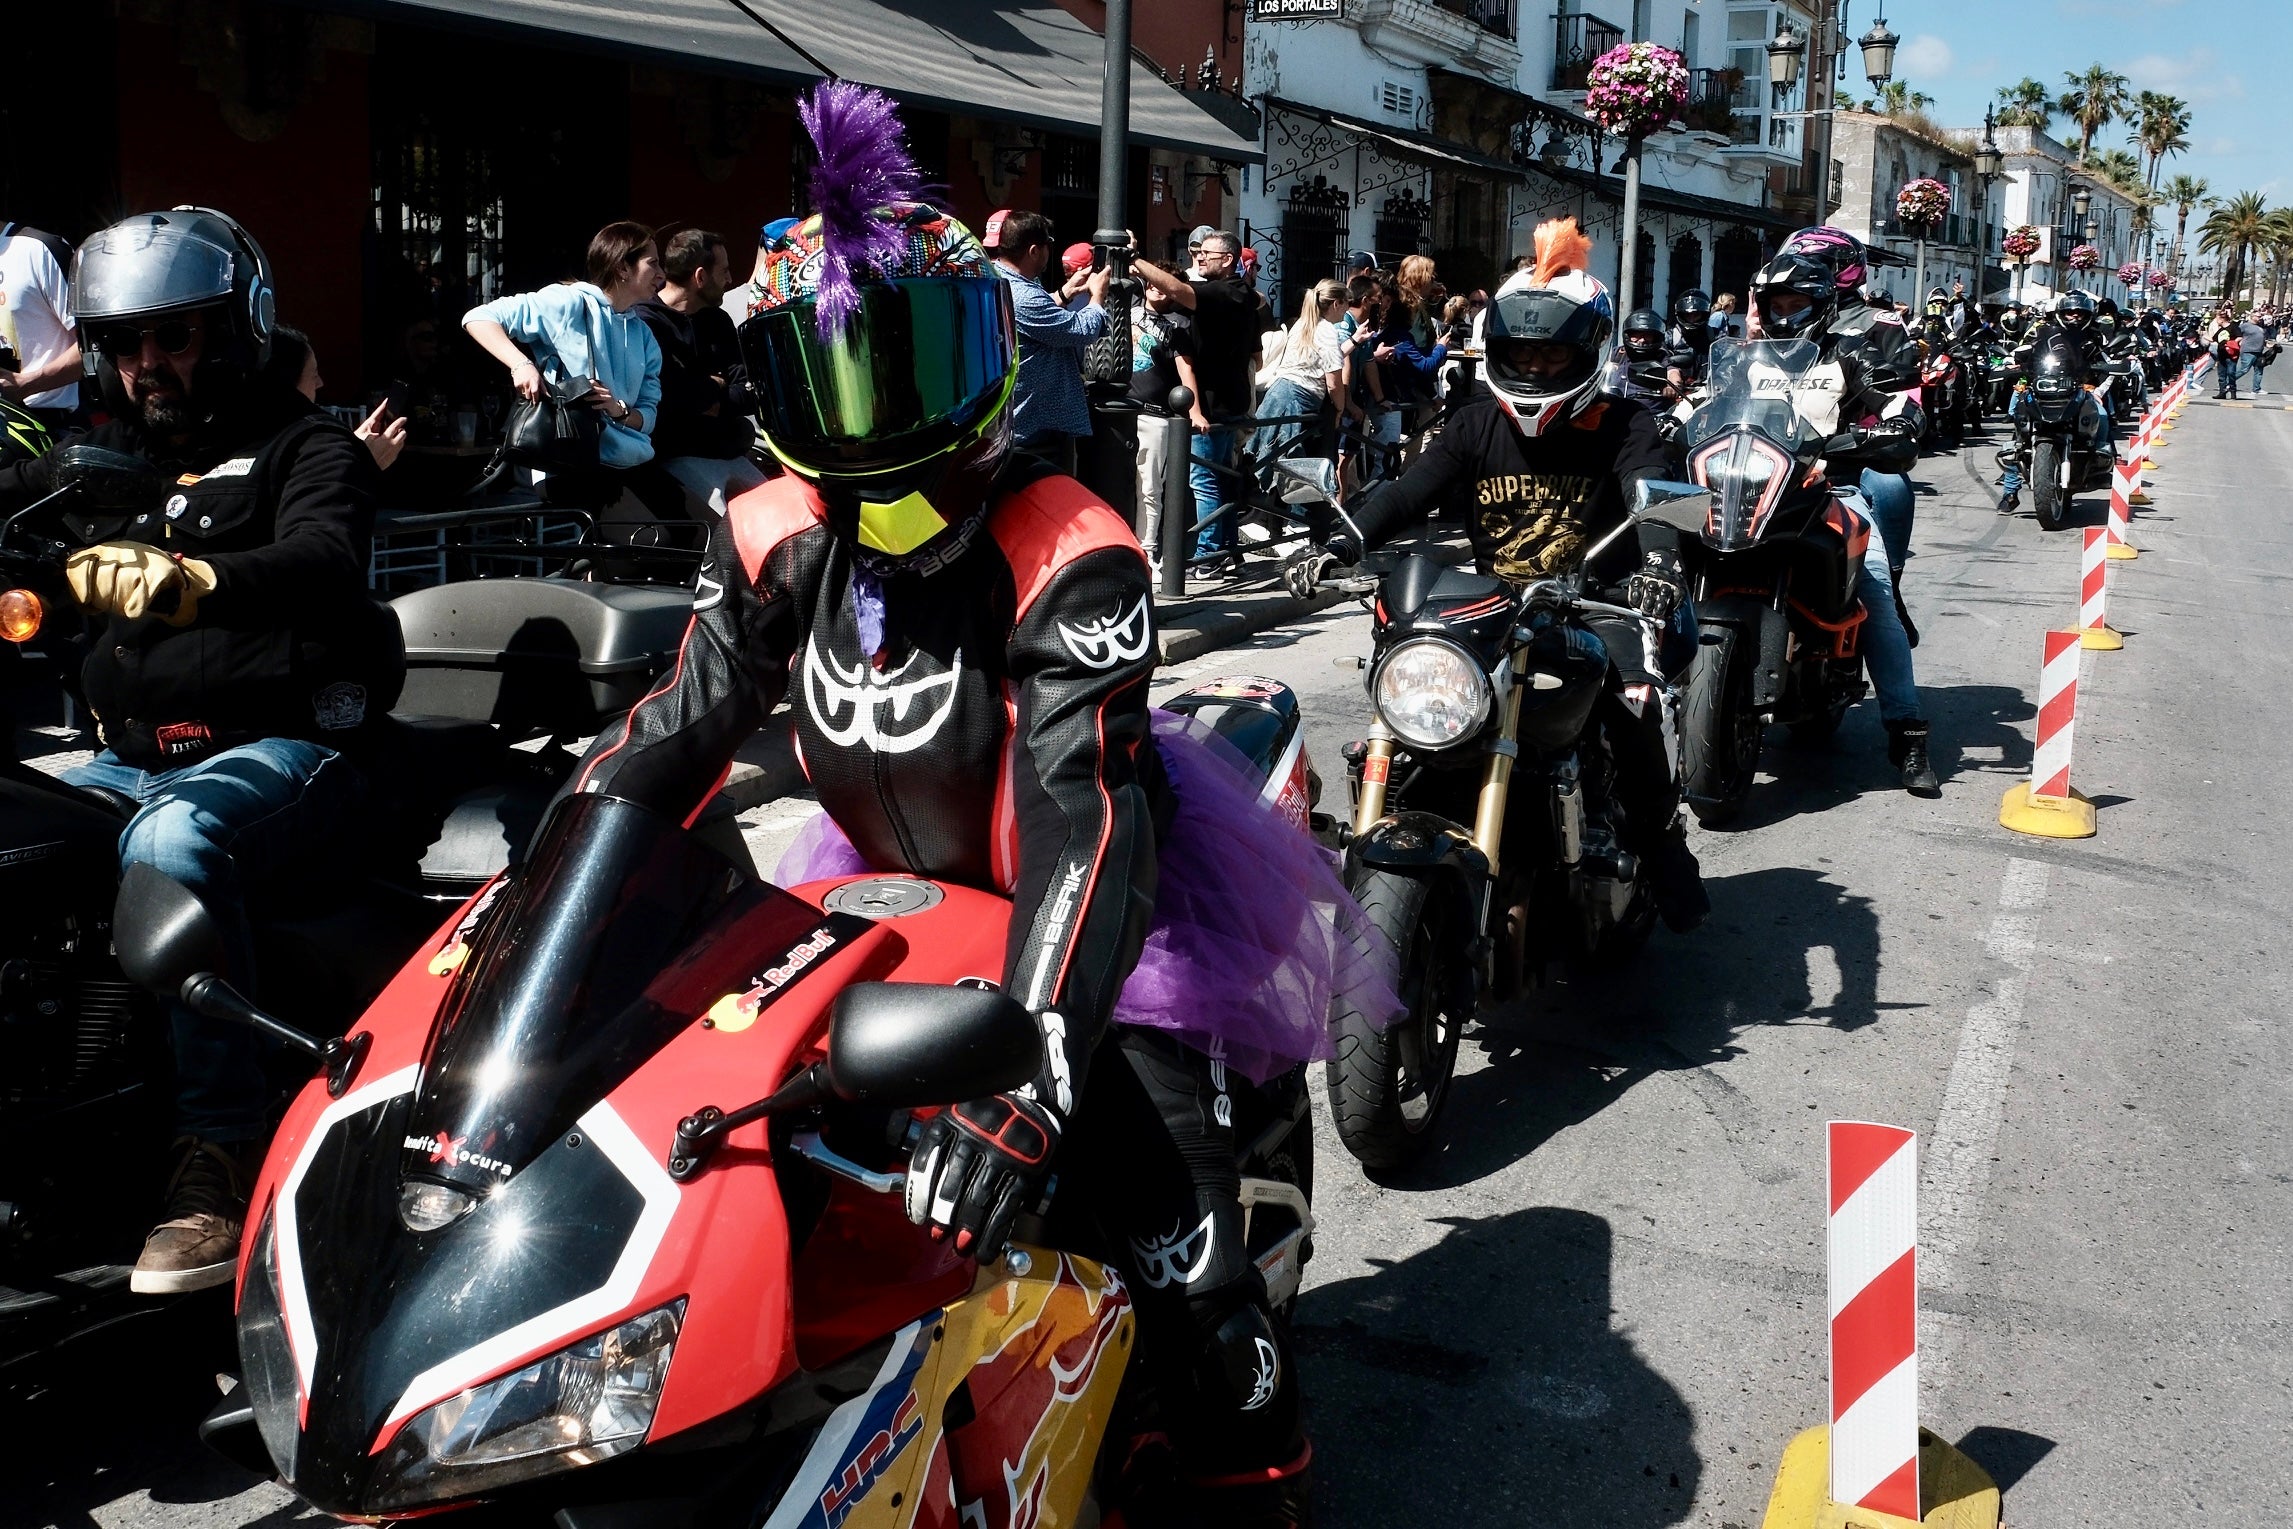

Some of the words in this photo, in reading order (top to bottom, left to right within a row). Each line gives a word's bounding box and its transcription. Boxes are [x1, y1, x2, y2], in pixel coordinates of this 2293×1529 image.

[1258, 0, 1279, 13] LOS
[1281, 0, 1337, 12] PORTALES
[1510, 325, 1551, 334] SHARK
[1756, 378, 1833, 390] DAINESE
[1477, 474, 1593, 505] SUPERBIKE
[1042, 861, 1088, 944] BERIK
